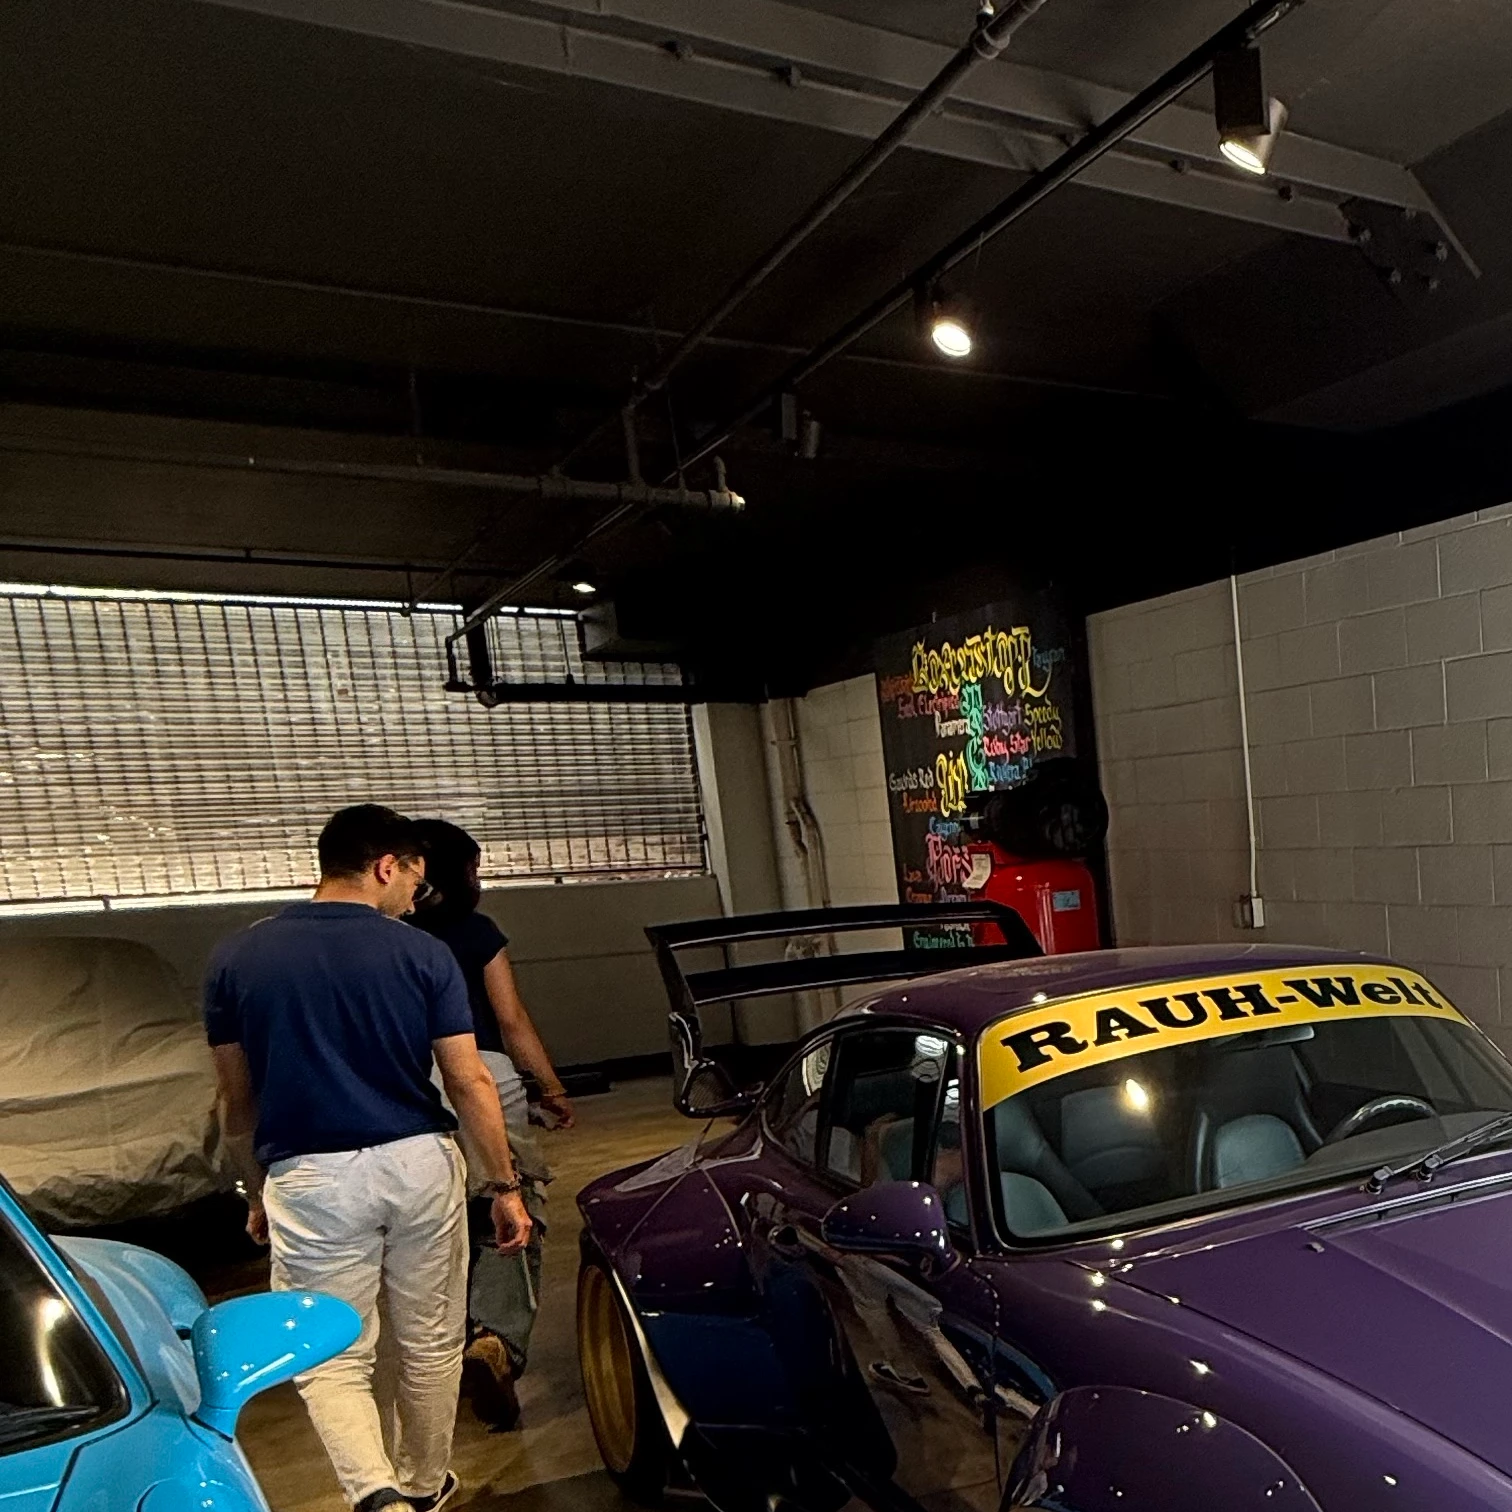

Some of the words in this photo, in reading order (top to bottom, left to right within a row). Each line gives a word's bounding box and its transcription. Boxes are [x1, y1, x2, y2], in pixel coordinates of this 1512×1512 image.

[1009, 732, 1031, 754] Star
[917, 766, 934, 790] Red
[1001, 976, 1443, 1072] RAUH-Welt
